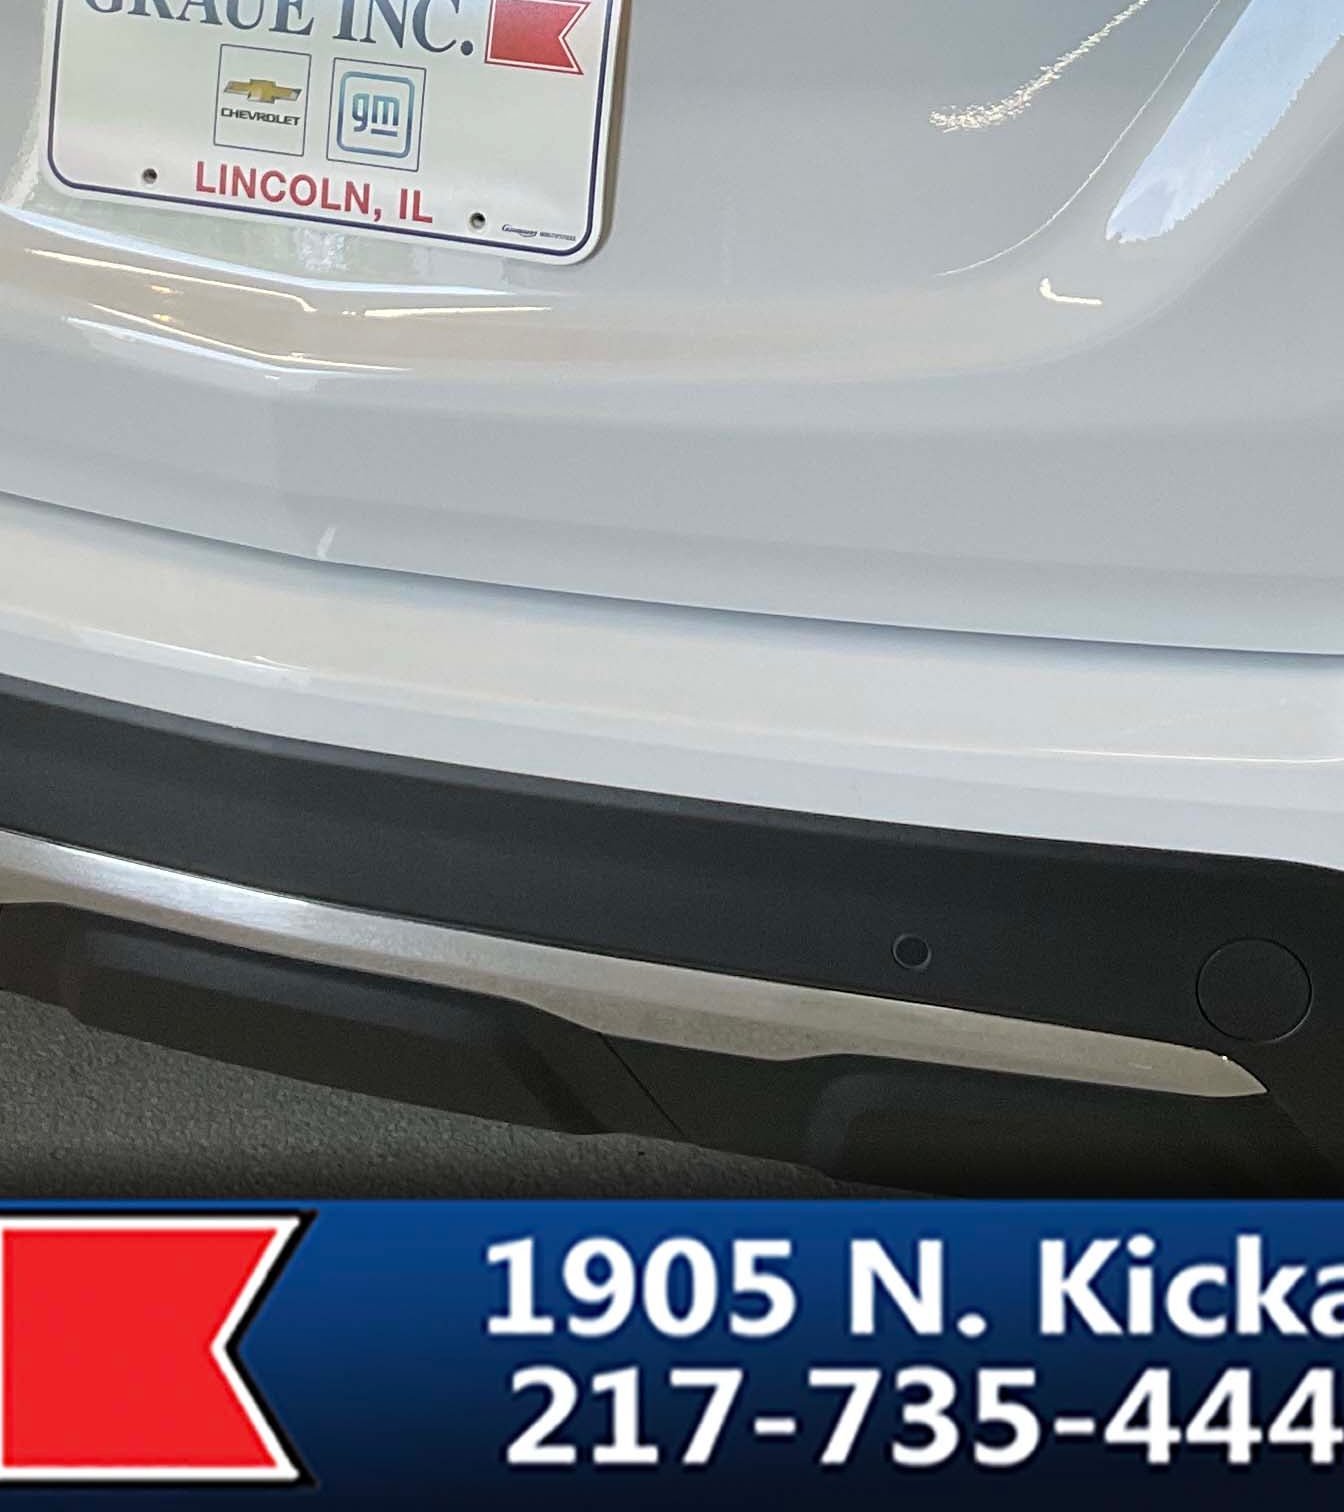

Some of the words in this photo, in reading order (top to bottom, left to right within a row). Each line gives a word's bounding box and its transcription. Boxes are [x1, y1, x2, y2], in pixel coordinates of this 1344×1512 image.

[221, 107, 301, 126] CHEVROLET
[352, 93, 401, 135] gm
[195, 161, 382, 222] LINCOLN,
[399, 188, 433, 224] IL
